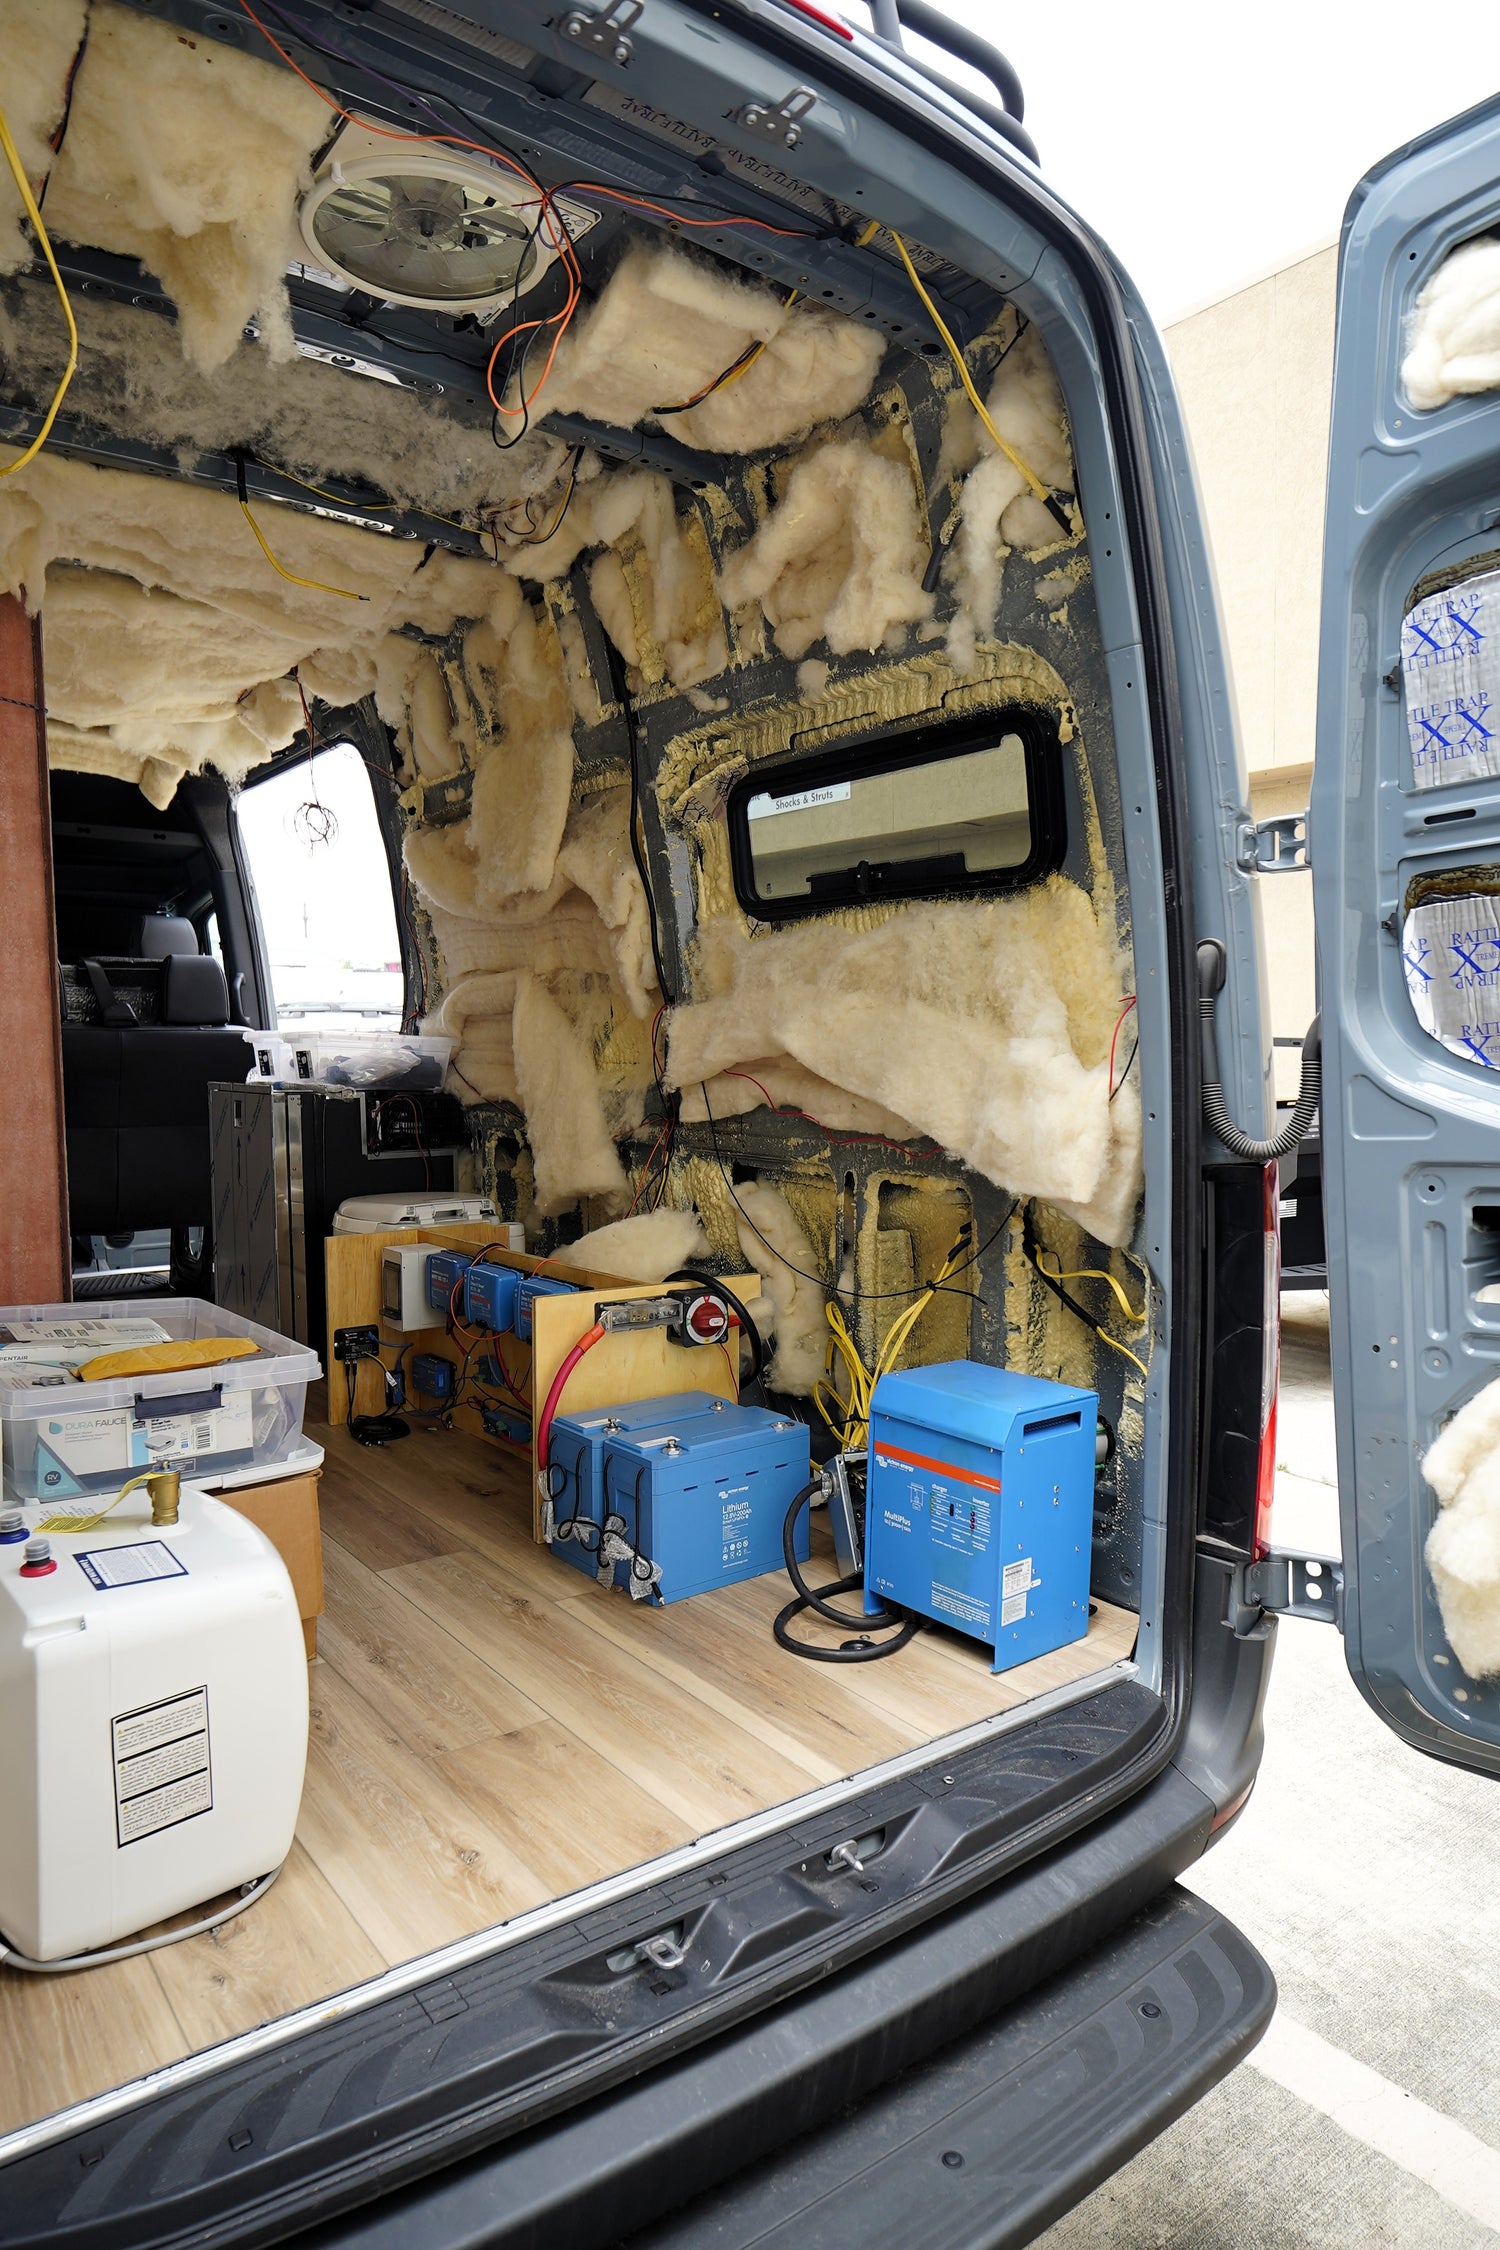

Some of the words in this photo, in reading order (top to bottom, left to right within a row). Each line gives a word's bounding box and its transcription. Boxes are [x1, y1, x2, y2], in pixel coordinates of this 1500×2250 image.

[1445, 691, 1489, 714] TRAP
[1429, 739, 1489, 764] RATTLE
[775, 795, 801, 811] Shocks
[802, 796, 809, 805] &
[811, 789, 834, 803] Struts
[65, 1421, 94, 1432] DURA
[47, 1473, 59, 1482] RV
[722, 1502, 749, 1514] Lithium
[884, 1510, 912, 1526] MultiPlus
